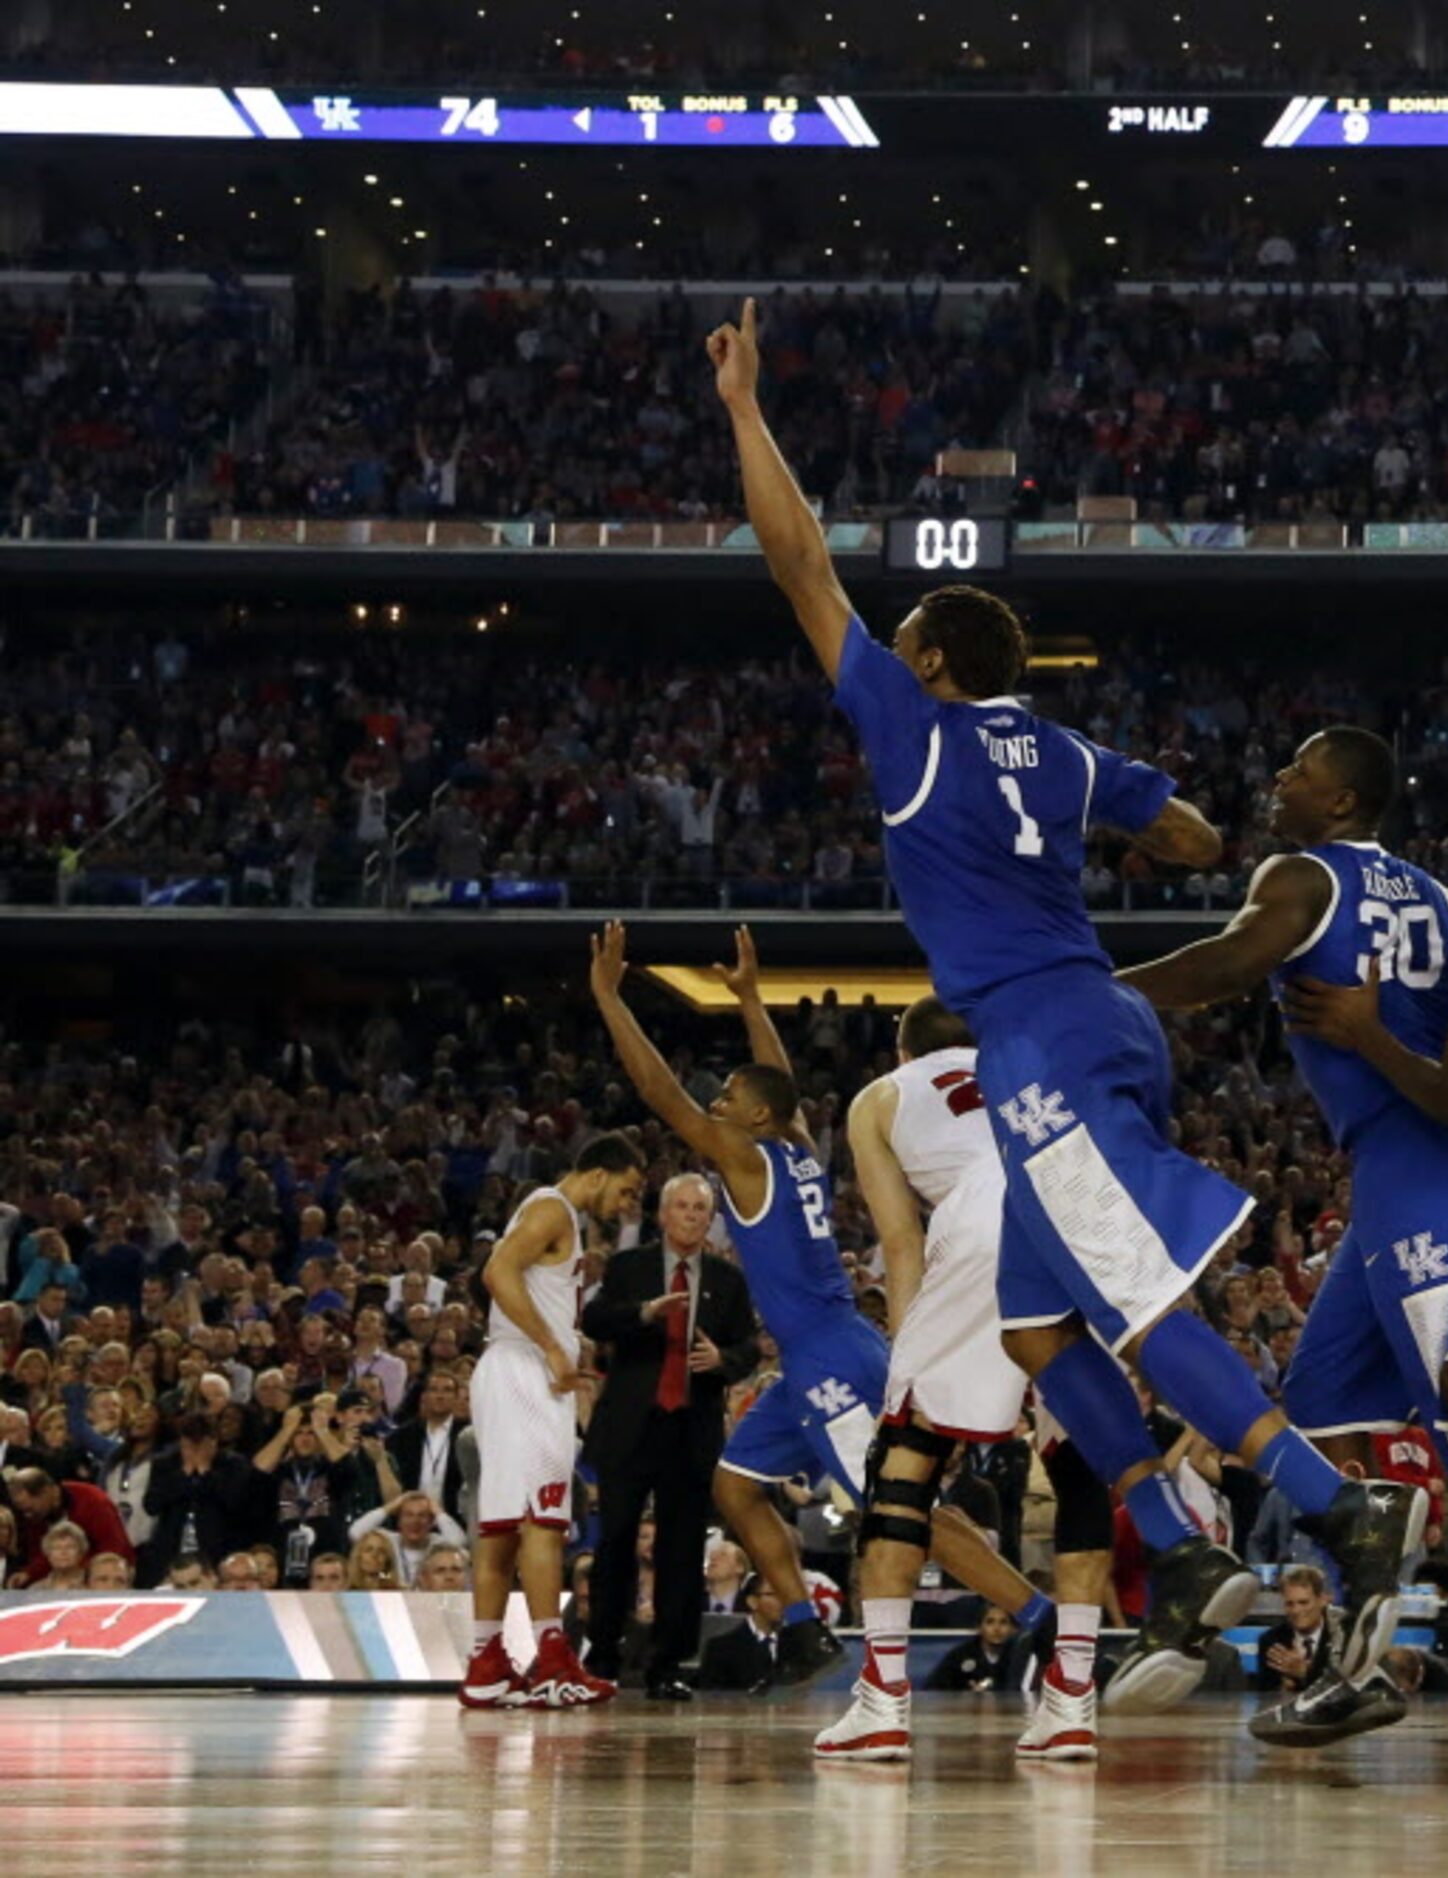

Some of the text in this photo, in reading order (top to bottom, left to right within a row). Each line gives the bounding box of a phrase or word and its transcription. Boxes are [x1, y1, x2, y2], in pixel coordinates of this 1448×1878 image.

[440, 97, 500, 136] 74
[627, 96, 798, 111] TOL BONUS FLS
[1108, 106, 1209, 131] 2ND HALF
[1336, 97, 1371, 112] FLS
[640, 112, 796, 143] 1 6
[1342, 112, 1370, 144] 9
[997, 774, 1045, 857] 1
[1356, 899, 1445, 989] 30
[998, 1082, 1076, 1147] UK
[797, 1182, 831, 1239] 2
